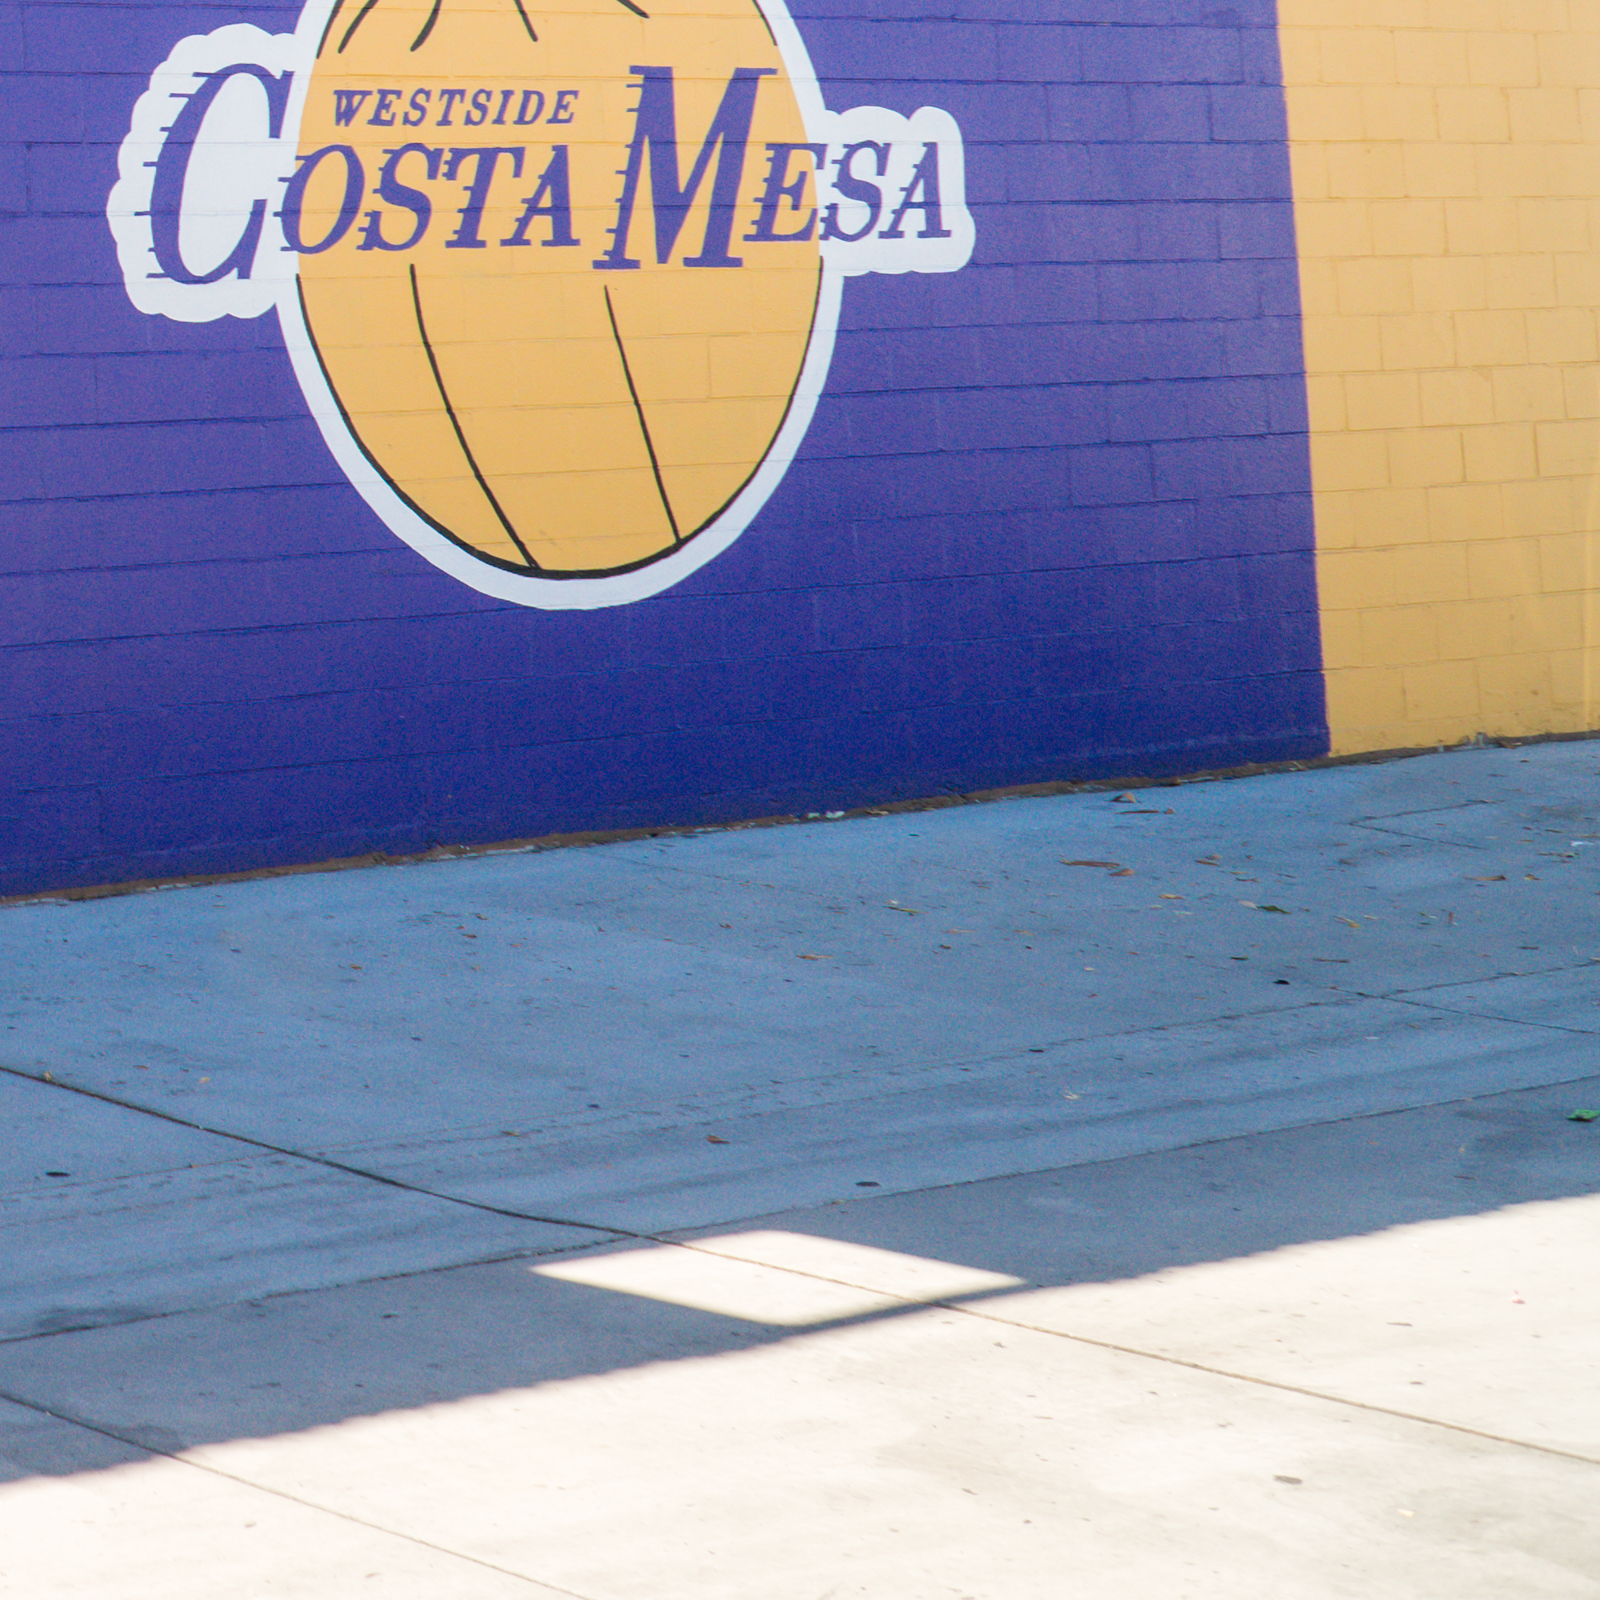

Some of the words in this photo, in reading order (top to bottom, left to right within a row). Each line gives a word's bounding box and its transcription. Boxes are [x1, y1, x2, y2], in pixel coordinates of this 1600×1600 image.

[332, 87, 580, 128] WESTSIDE
[134, 62, 582, 286] COSTA
[592, 64, 952, 270] MESA
